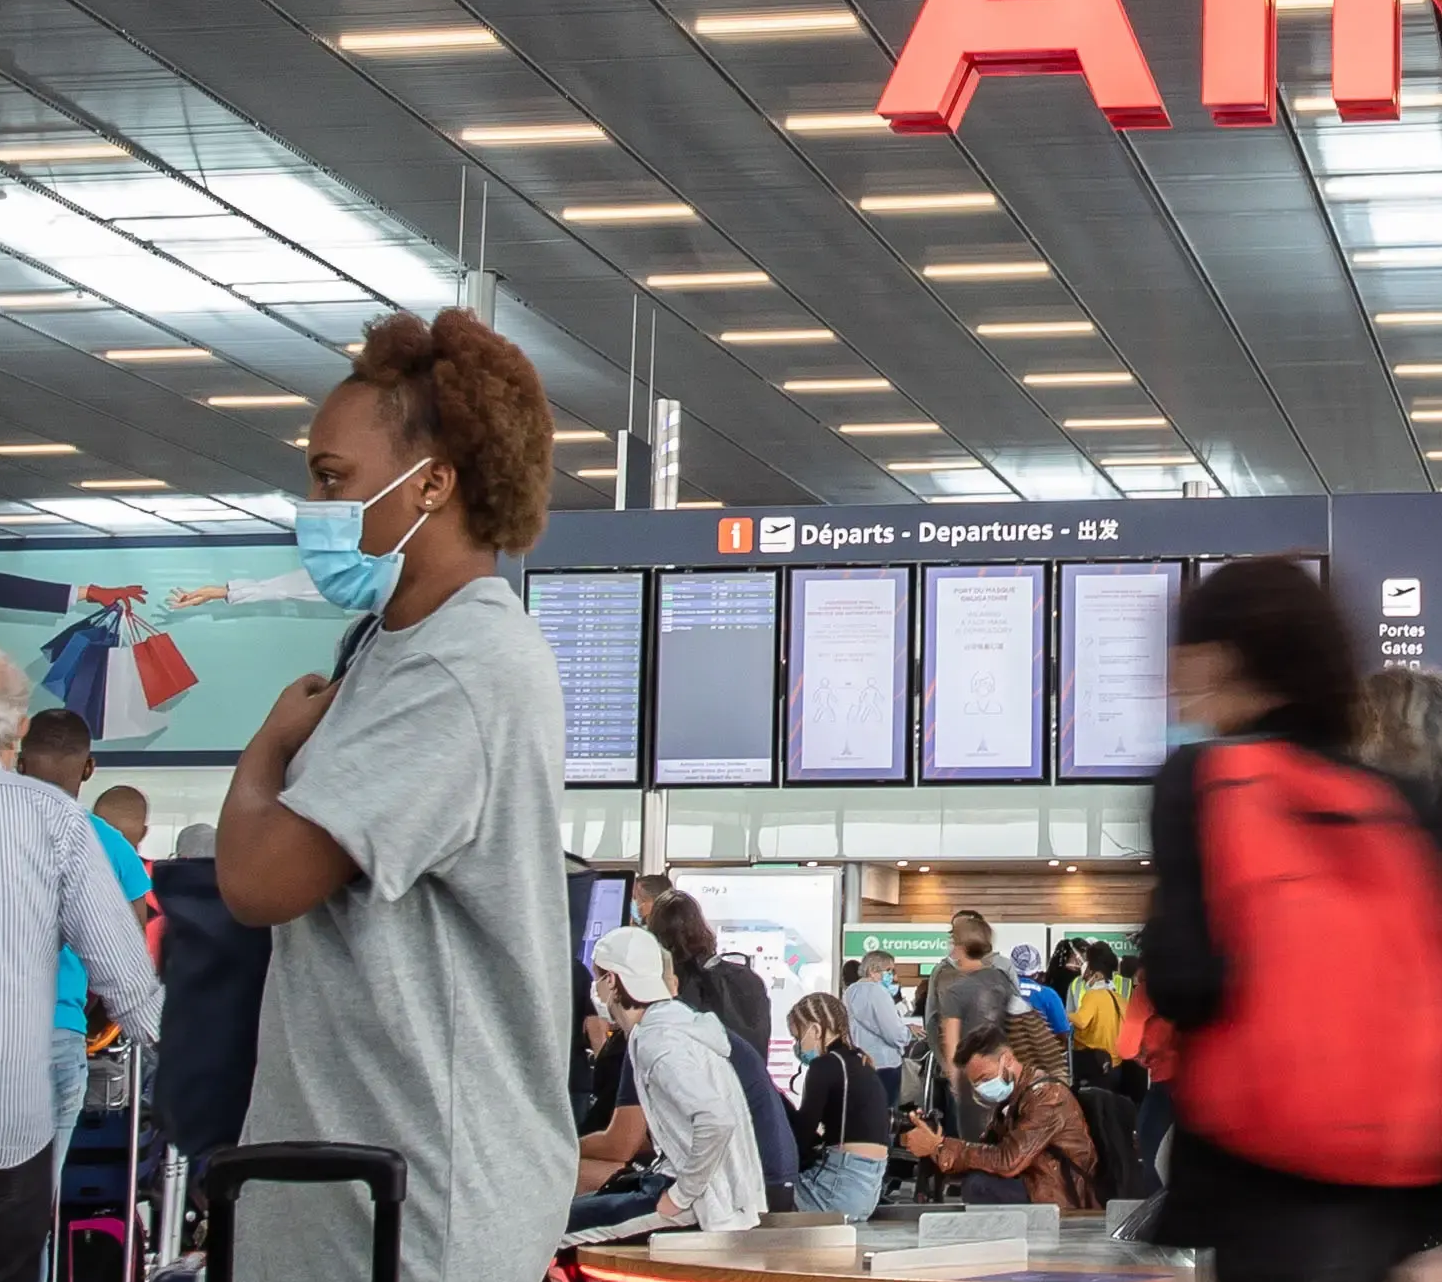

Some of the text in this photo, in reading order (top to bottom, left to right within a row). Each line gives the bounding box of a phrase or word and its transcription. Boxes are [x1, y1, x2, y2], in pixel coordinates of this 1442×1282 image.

[801, 519, 1054, 550] Départs Departures
[1077, 518, 1120, 542] 出发
[1379, 623, 1425, 638] Portes
[1381, 640, 1424, 656] Gates
[882, 937, 947, 950] transavia
